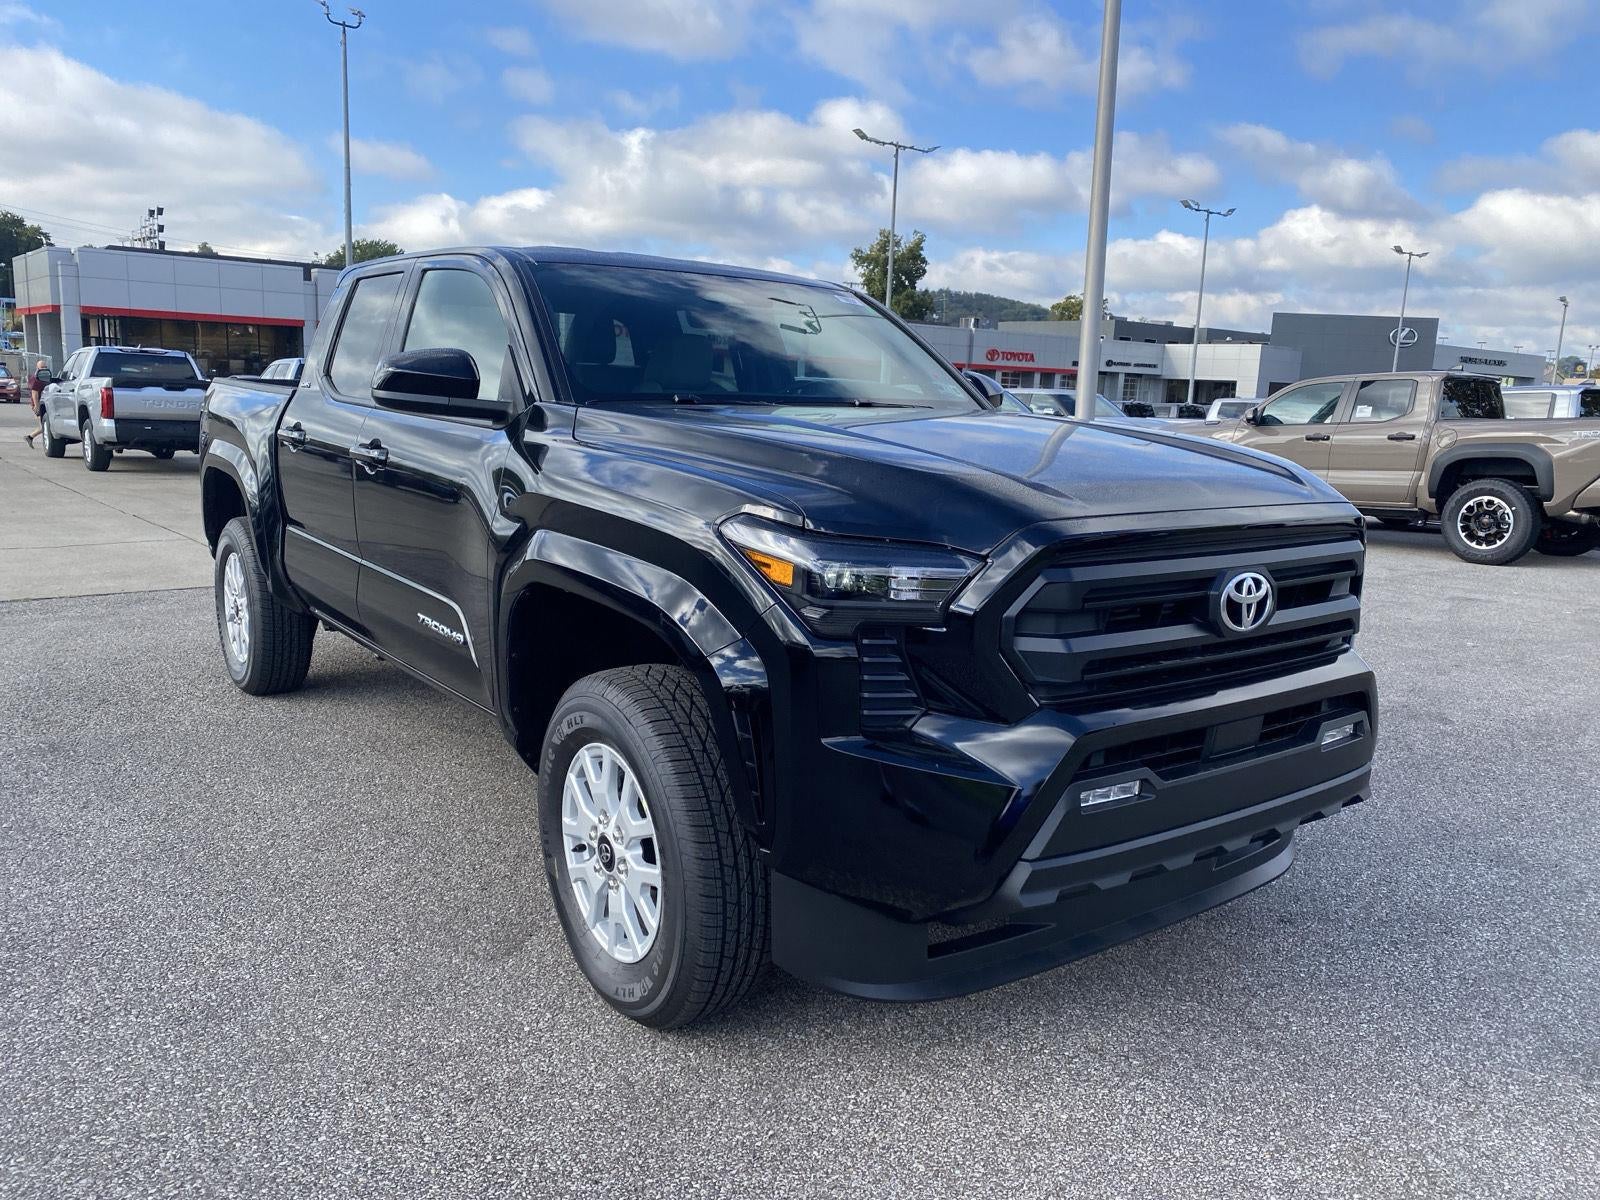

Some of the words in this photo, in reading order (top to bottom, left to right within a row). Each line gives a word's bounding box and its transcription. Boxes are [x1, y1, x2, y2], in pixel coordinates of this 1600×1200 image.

[1000, 351, 1035, 363] TOYOTA
[142, 400, 200, 409] TUNDR
[417, 612, 464, 644] TACOMA
[566, 715, 584, 729] HLT
